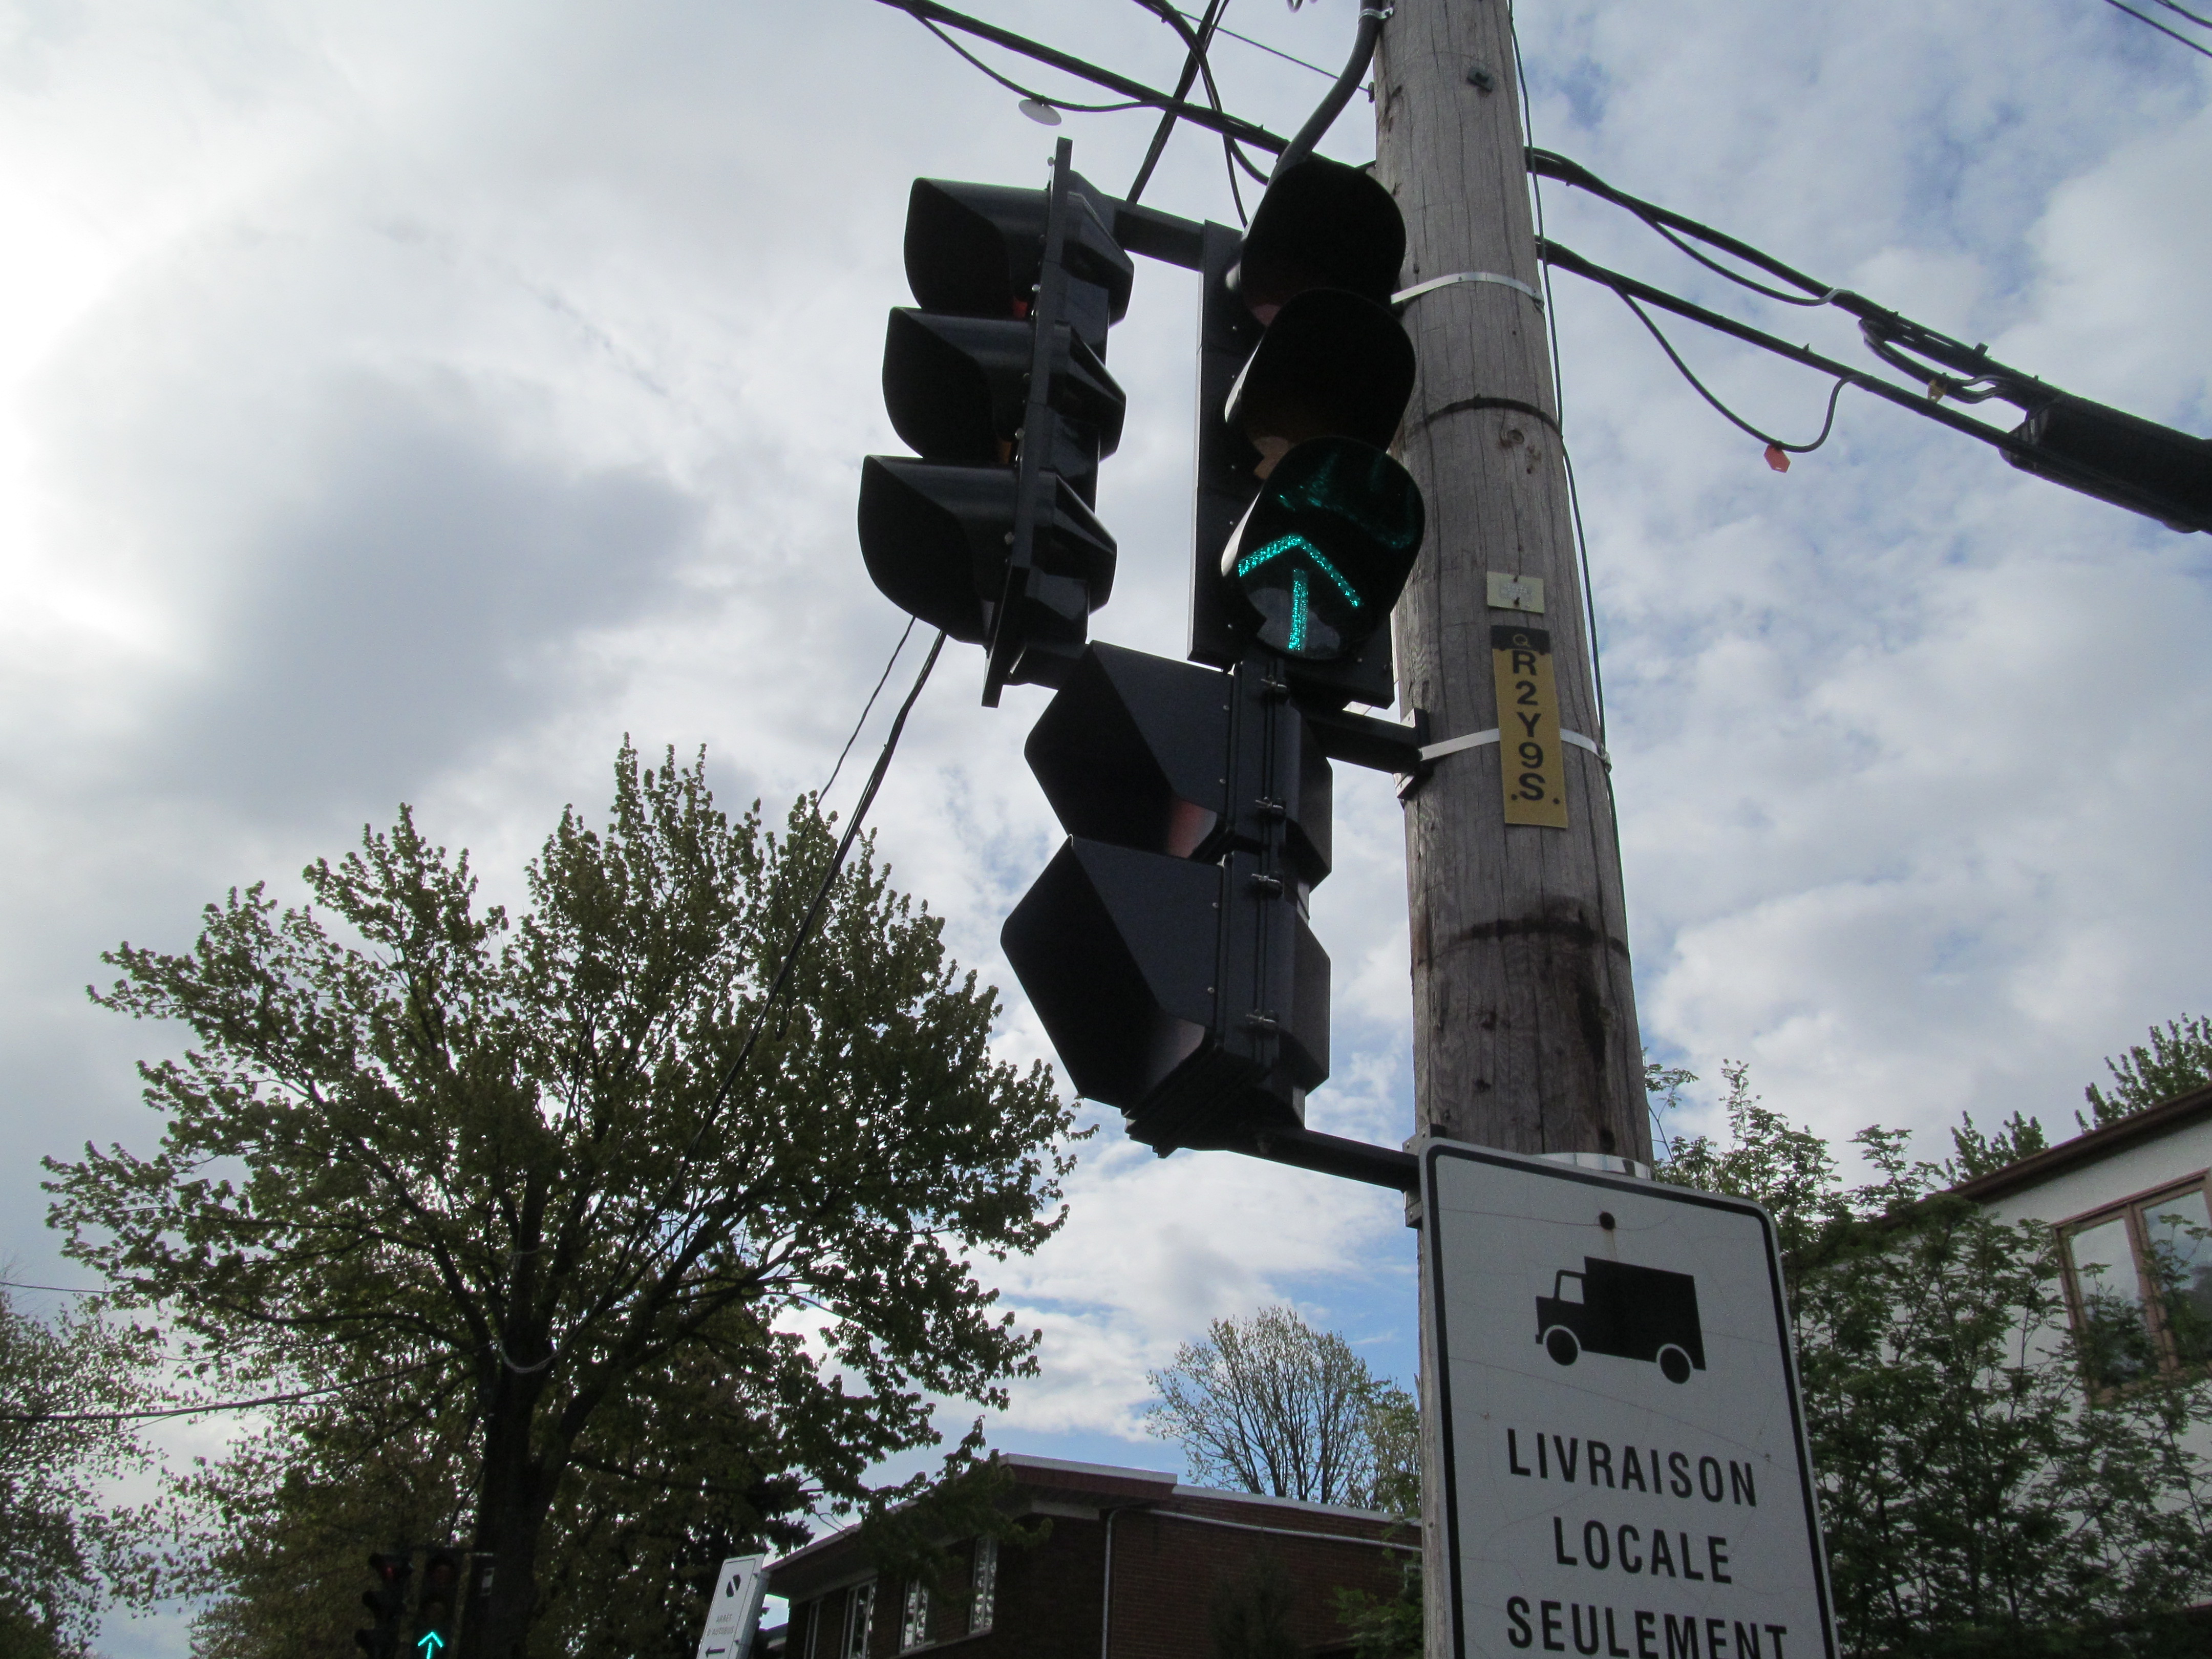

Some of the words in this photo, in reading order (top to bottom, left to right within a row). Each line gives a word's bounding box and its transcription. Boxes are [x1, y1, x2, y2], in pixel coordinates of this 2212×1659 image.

[1513, 650, 1545, 801] R2Y9S
[1507, 1428, 1756, 1506] LIVRAISON
[1554, 1516, 1732, 1584] LOCALE
[1507, 1596, 1787, 1659] SEULEMENT
